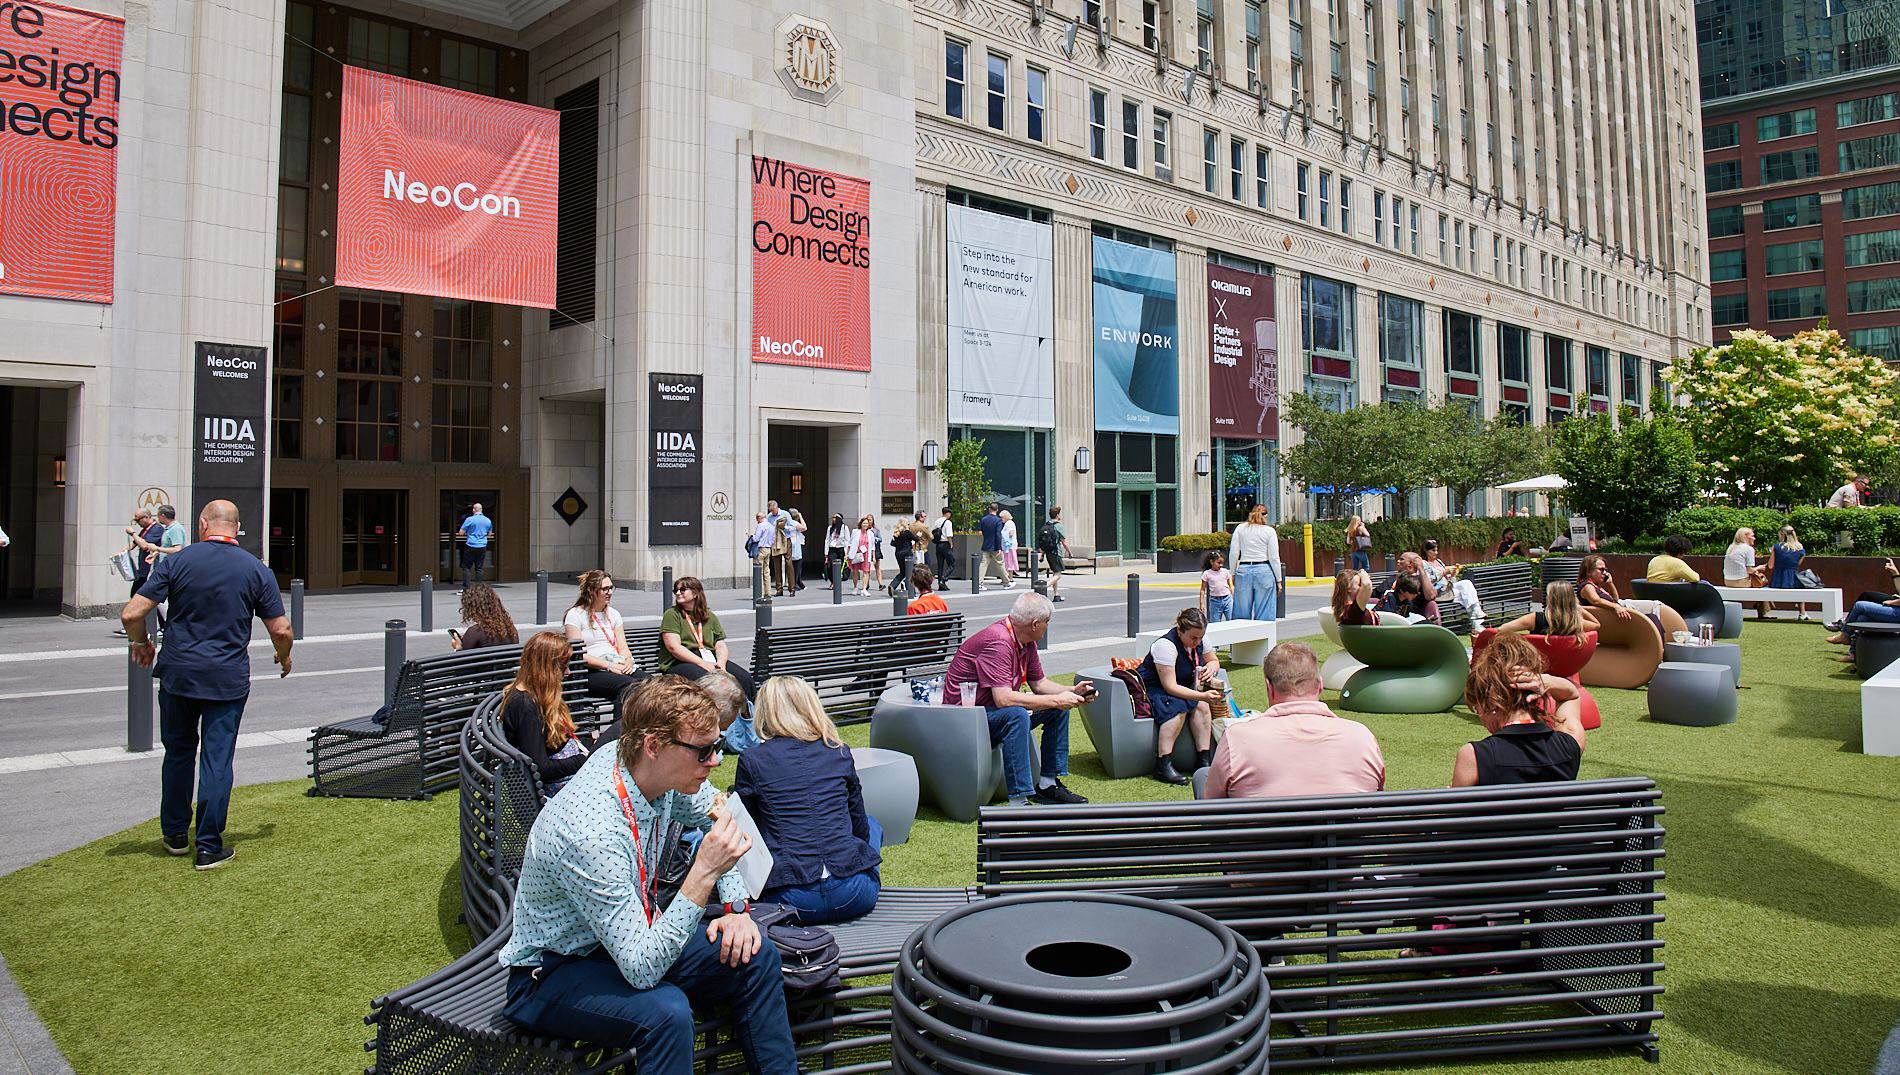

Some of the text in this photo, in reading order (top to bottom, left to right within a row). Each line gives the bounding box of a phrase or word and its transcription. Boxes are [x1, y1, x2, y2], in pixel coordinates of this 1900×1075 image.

[0, 100, 119, 149] ects
[752, 155, 836, 198] Where
[383, 168, 521, 218] NeoCon
[790, 193, 870, 242] Design
[753, 220, 870, 269] Connects
[963, 246, 1016, 266] Step into the
[963, 264, 1033, 283] new standard for
[963, 278, 1027, 297] American work.
[1213, 324, 1240, 336] Foster +
[760, 335, 824, 359] NeoCon
[1213, 334, 1241, 346] Partners
[1213, 344, 1243, 357] Industrial
[207, 354, 257, 370] NeoCon
[1213, 354, 1237, 367] Design
[212, 370, 249, 379] WELCOMES
[658, 383, 696, 394] NeoCon
[963, 393, 992, 406] framery
[204, 417, 256, 441] IIDA
[656, 432, 696, 451] IIDA
[888, 476, 912, 484] NeoCon
[621, 796, 636, 827] NeoCon
